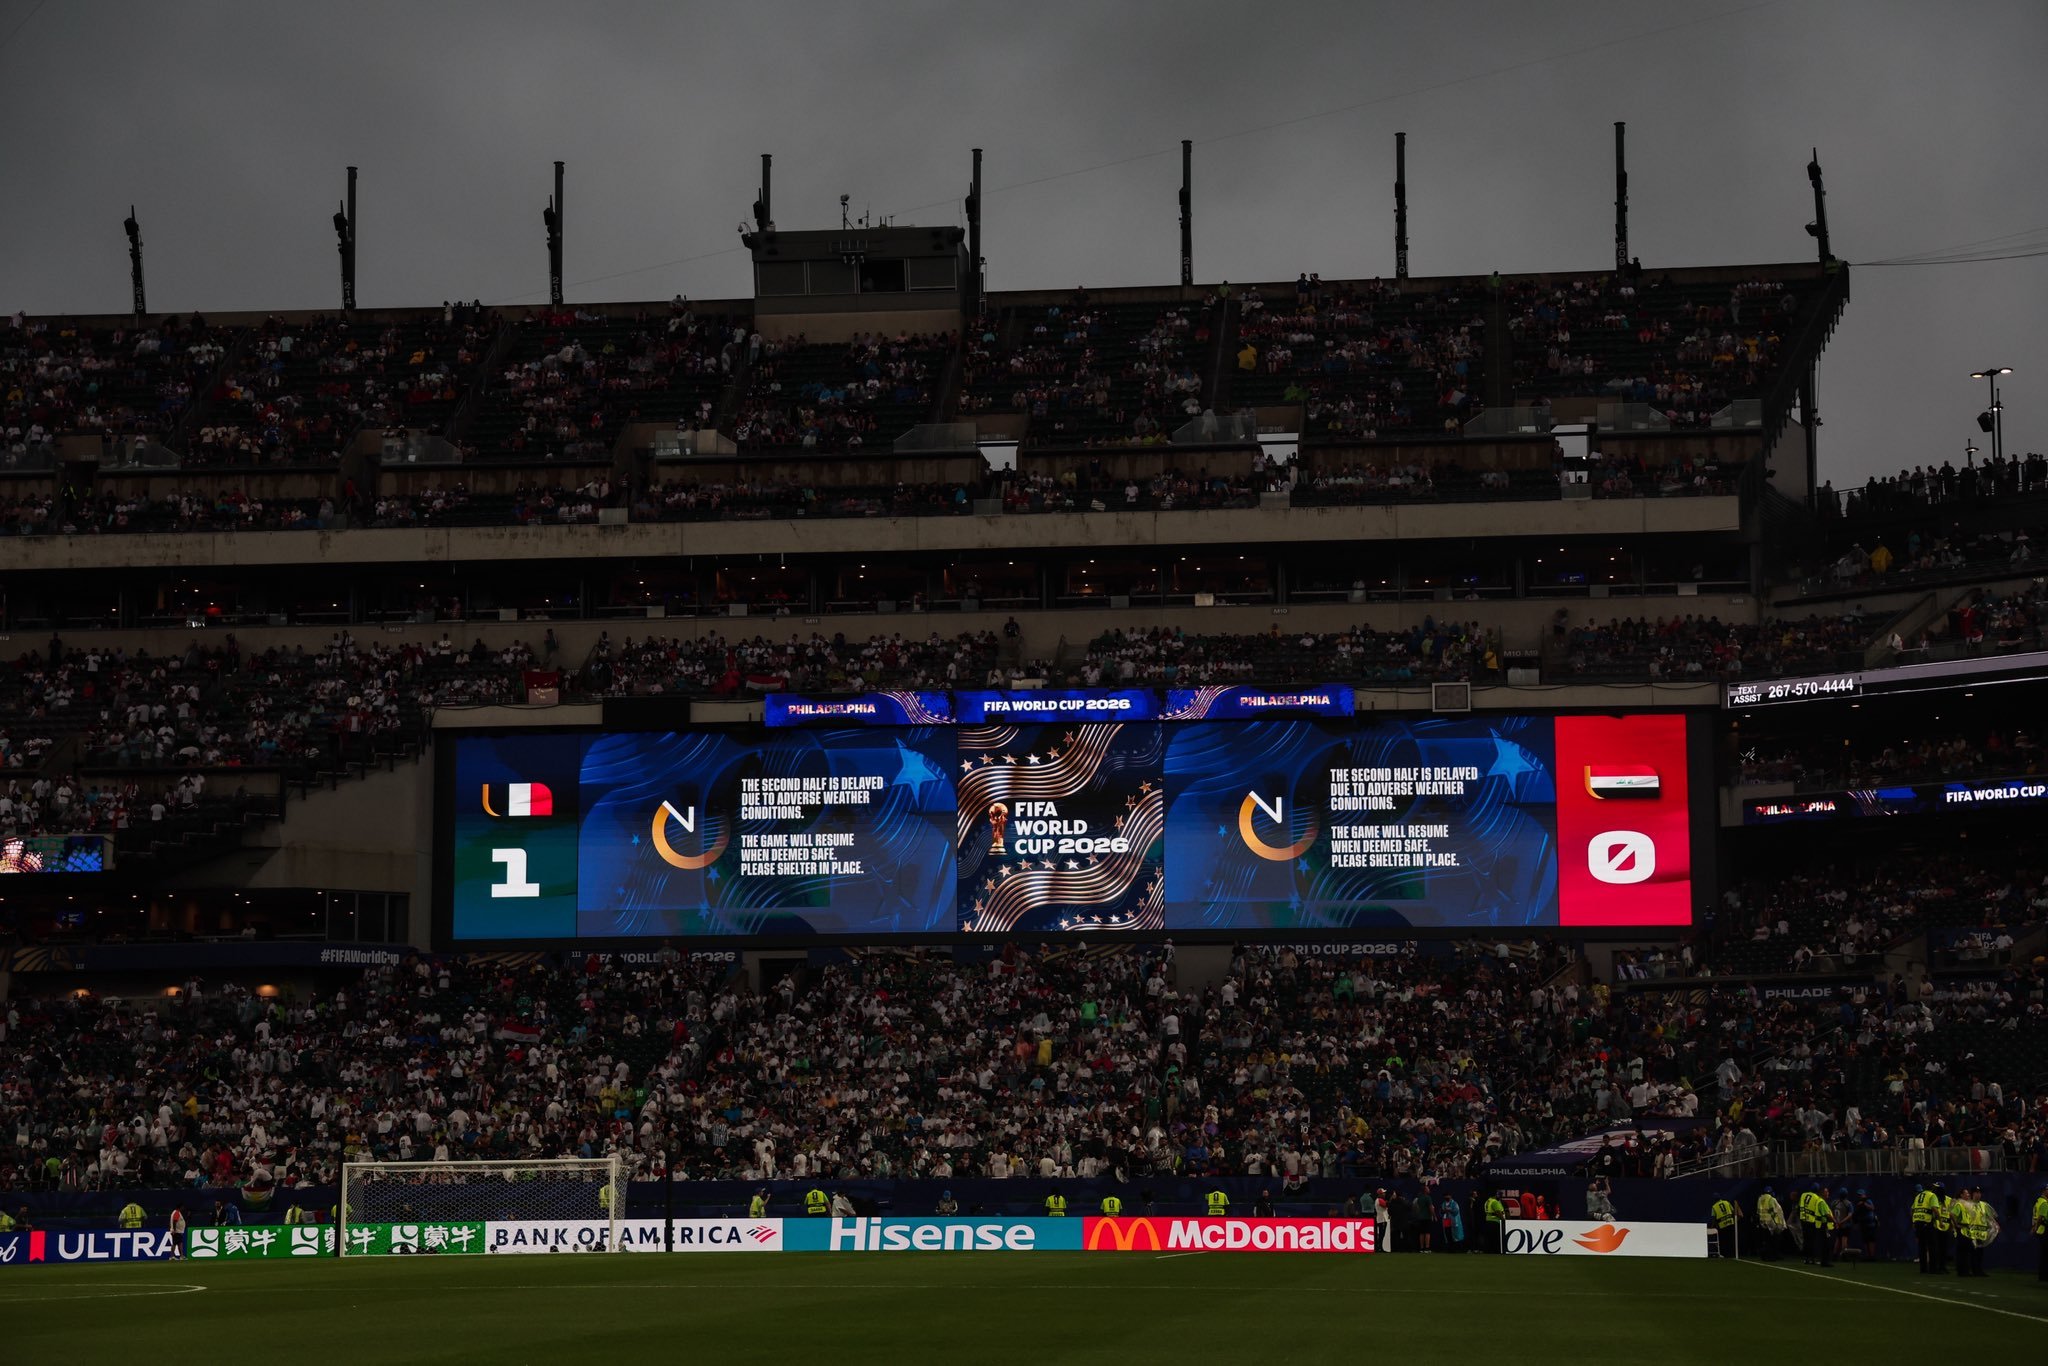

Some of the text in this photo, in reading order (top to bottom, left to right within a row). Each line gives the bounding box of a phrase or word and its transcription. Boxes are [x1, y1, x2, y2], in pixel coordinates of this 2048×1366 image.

[1618, 241, 1626, 266] 209
[1183, 257, 1191, 280] 211
[1398, 250, 1406, 274] 210
[344, 281, 352, 305] 214
[552, 276, 560, 300] 213
[135, 287, 145, 310] 215
[1737, 685, 1757, 695] TEXT
[1768, 678, 1854, 698] 267-570-4444
[984, 699, 1131, 712] FIFA WORLD CUP 2026
[1240, 695, 1330, 706] PHILADELPHIA
[1733, 693, 1762, 703] ASSIST
[788, 704, 876, 715] PHILADELPHIA
[1330, 767, 1478, 782] THE SECOND HALF IS DELAYED
[742, 776, 883, 792] THE SECOND HALF IS DELAYED
[1331, 782, 1464, 796] DUE TO ADVERSE WEATHER
[742, 791, 870, 806] DUE TO ADVERSE WEATHER
[1946, 785, 2046, 803] FIFA WORLD CUP
[1015, 801, 1058, 817] FIFA
[1331, 797, 1396, 810] CONDITIONS.
[742, 806, 804, 819] CONDITIONS.
[1014, 819, 1087, 836] WORLD
[1331, 825, 1448, 839] THE GAME WILL RESUME
[741, 834, 854, 848] THE GAME WILL RESUME
[1015, 837, 1129, 854] CUP 2026
[1332, 839, 1431, 853] WHEN DEEMED SAFE.
[741, 848, 837, 862] WHEN DEEMED SAFE.
[1332, 853, 1460, 868] PLEASE SHELTER IN PLACE.
[1588, 830, 1656, 884] 0
[491, 847, 540, 898] 1
[741, 861, 864, 875] PLEASE SHELTER IN PLACE.
[691, 951, 736, 962] 2026
[1323, 944, 1350, 955] CUP
[1351, 944, 1398, 954] 2026
[320, 949, 400, 967] #FIFAWorldCup
[1489, 1167, 1567, 1176] PHILADELPHIA
[224, 1228, 277, 1256] 蒙牛
[424, 1225, 475, 1252] 蒙牛
[495, 1228, 568, 1246] BANK
[577, 1227, 610, 1246] OF
[829, 1217, 1036, 1251] Hisense
[1167, 1220, 1375, 1251] McDonald's
[58, 1230, 179, 1260] ULTRA
